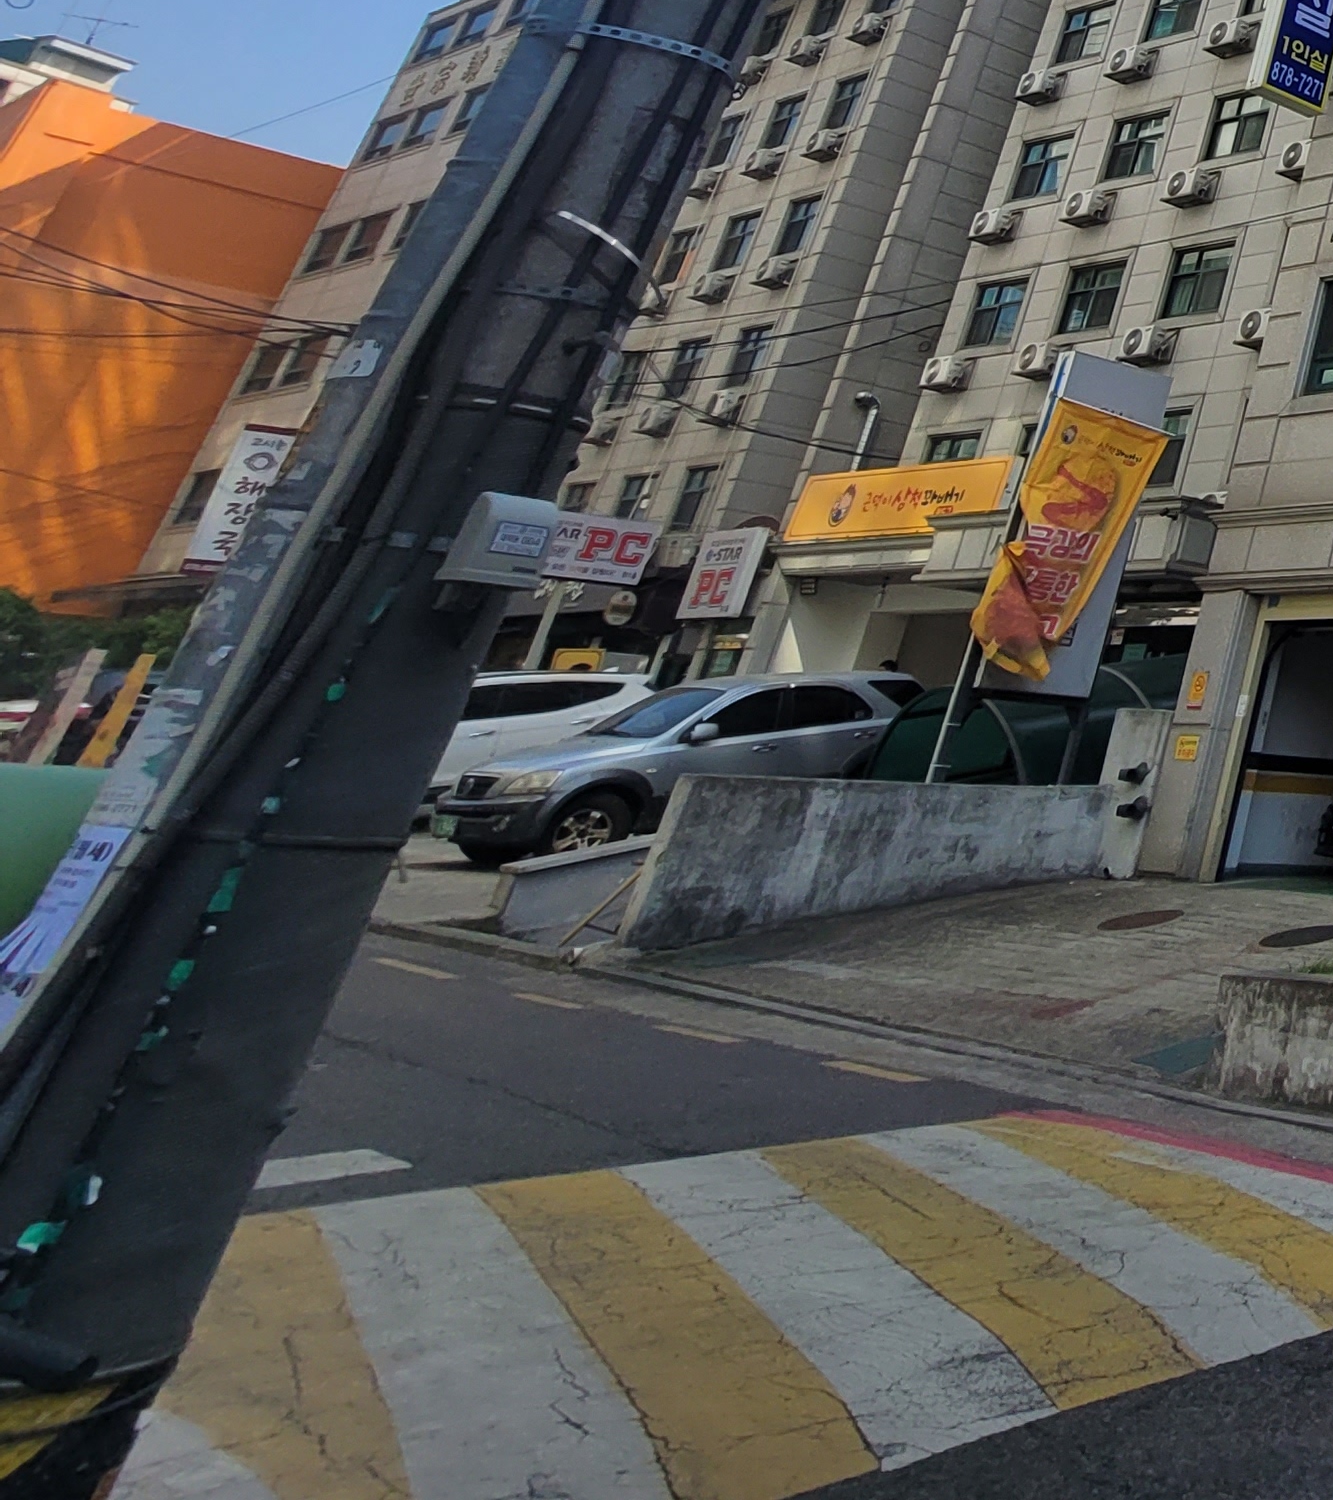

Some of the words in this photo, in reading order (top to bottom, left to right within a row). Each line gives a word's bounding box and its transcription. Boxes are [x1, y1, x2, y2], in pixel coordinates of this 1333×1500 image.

[1281, 34, 1329, 75] 1인실
[1270, 60, 1325, 102] 878-7271
[574, 525, 654, 568] PC
[687, 566, 737, 609] PC
